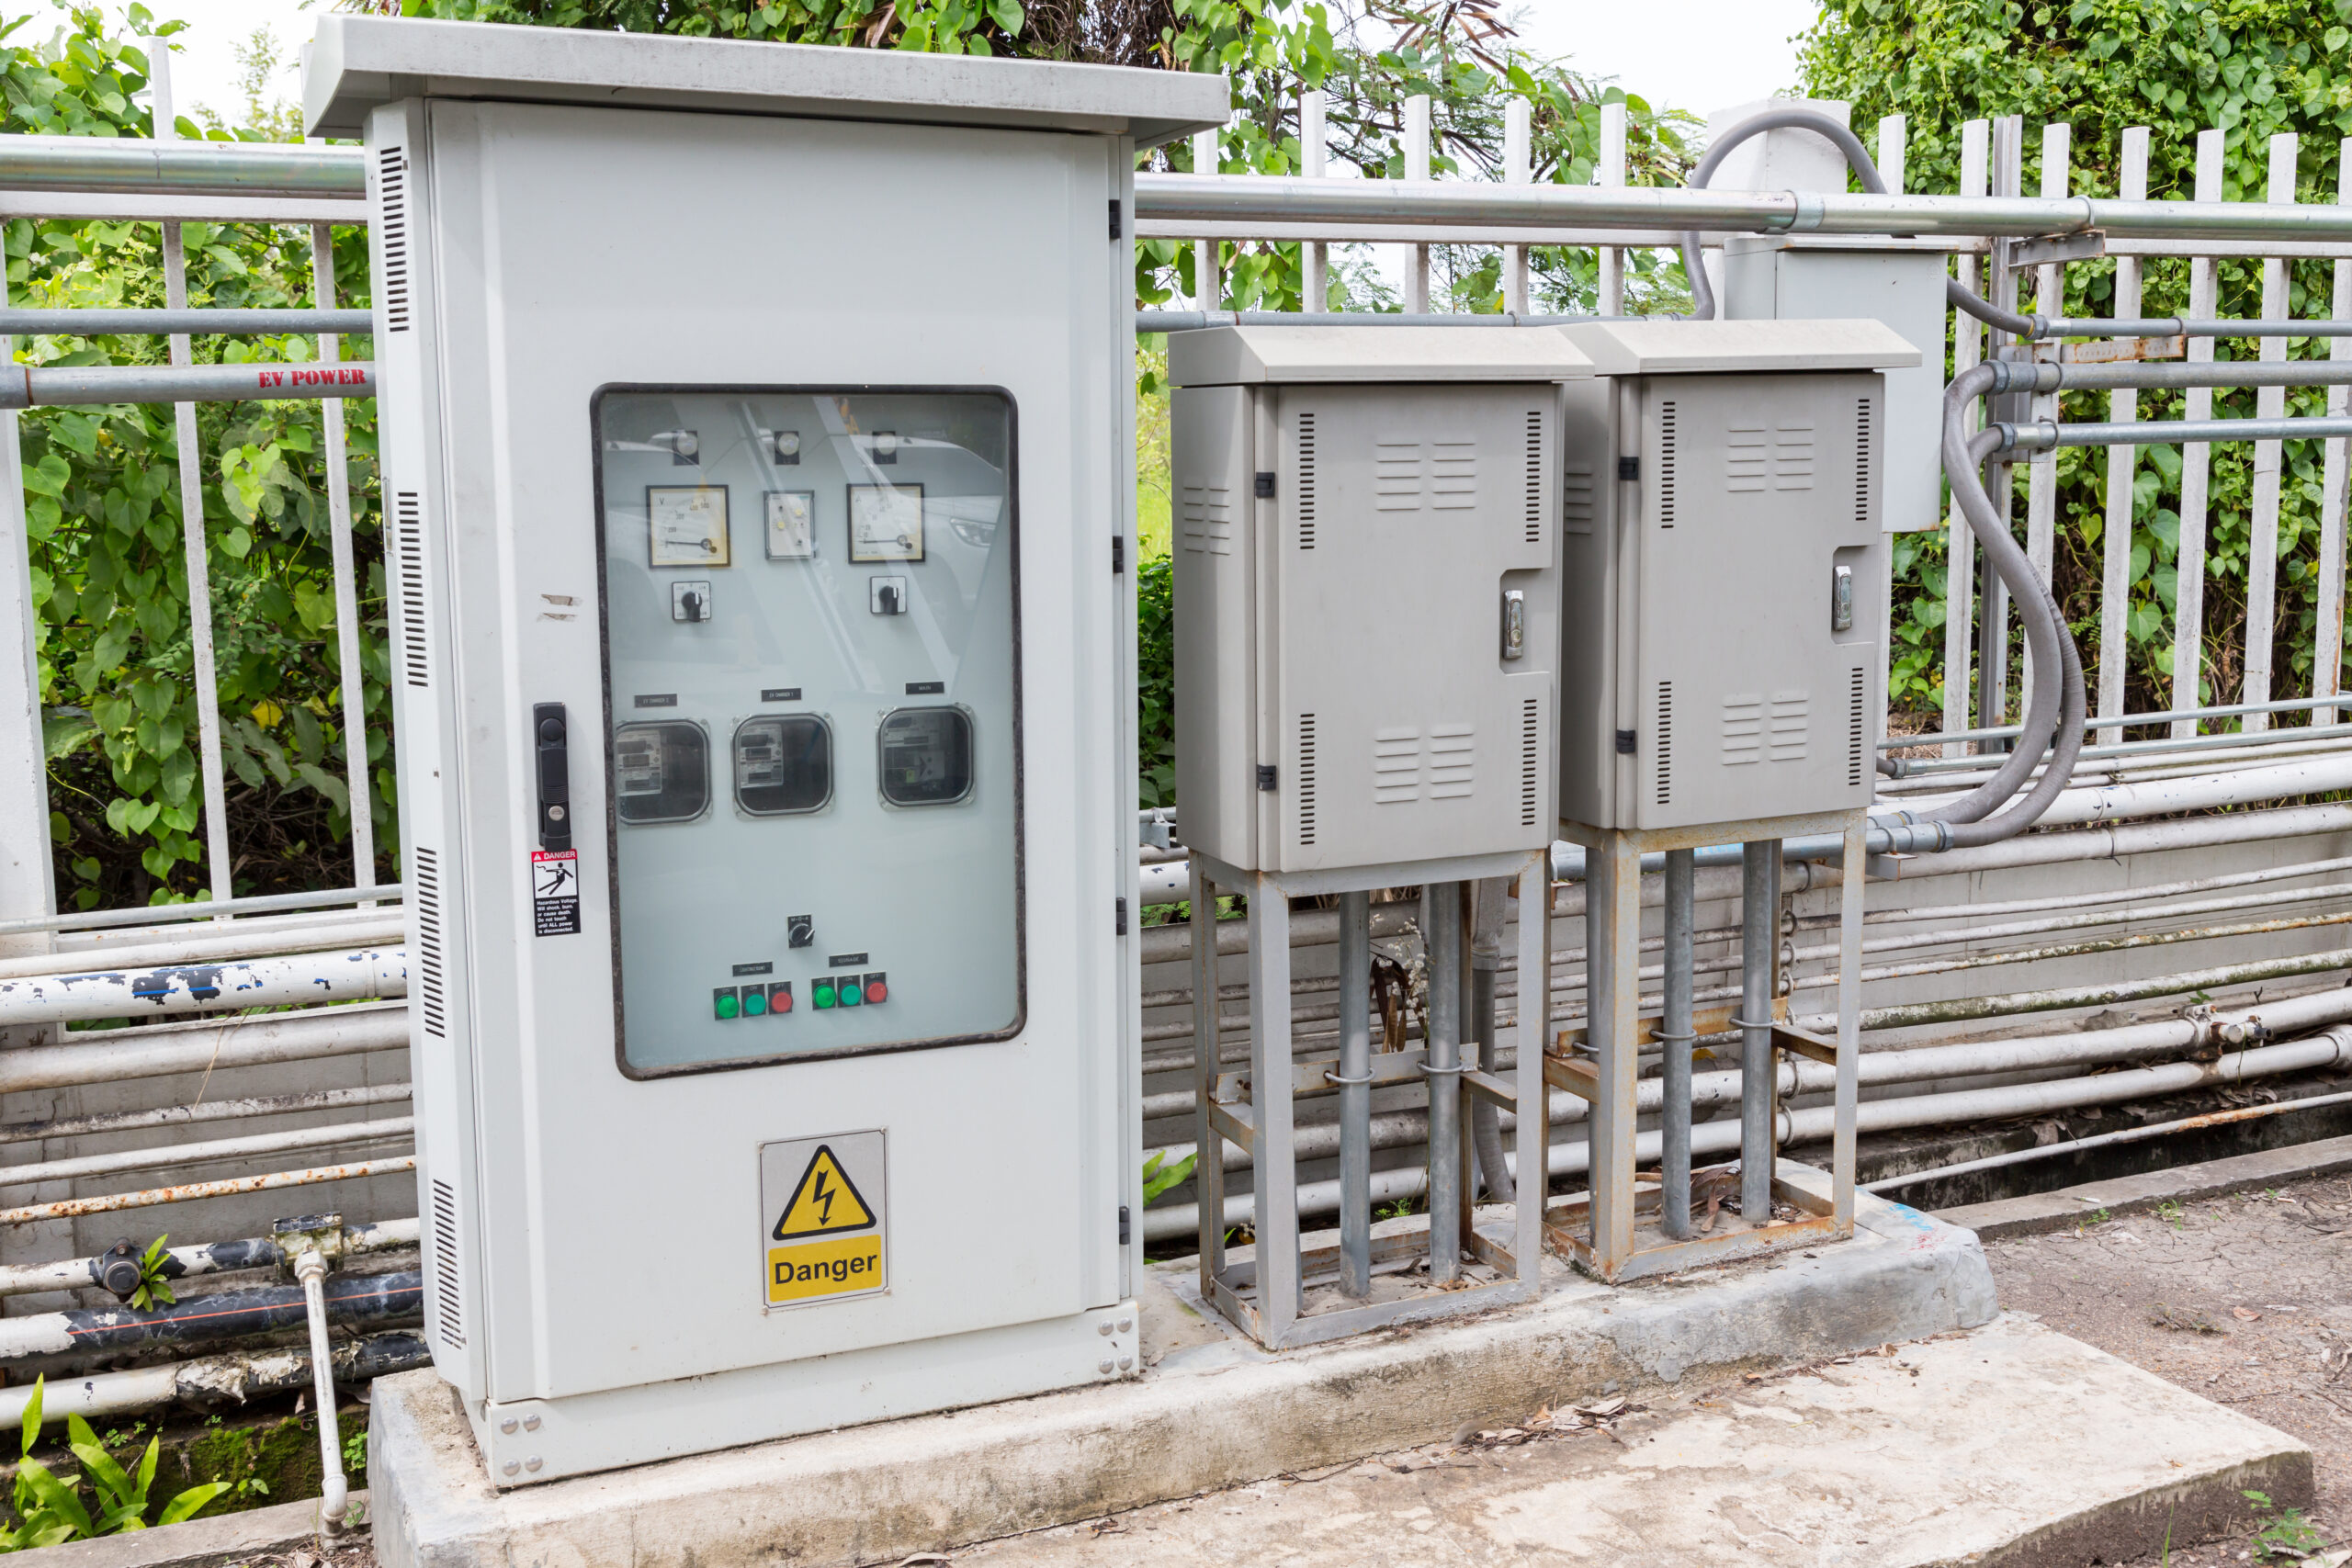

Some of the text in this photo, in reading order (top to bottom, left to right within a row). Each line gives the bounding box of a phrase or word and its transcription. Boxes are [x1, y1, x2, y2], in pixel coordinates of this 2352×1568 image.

[258, 368, 368, 389] EV POWER
[543, 851, 576, 860] DANGER
[775, 1254, 877, 1285] Danger
